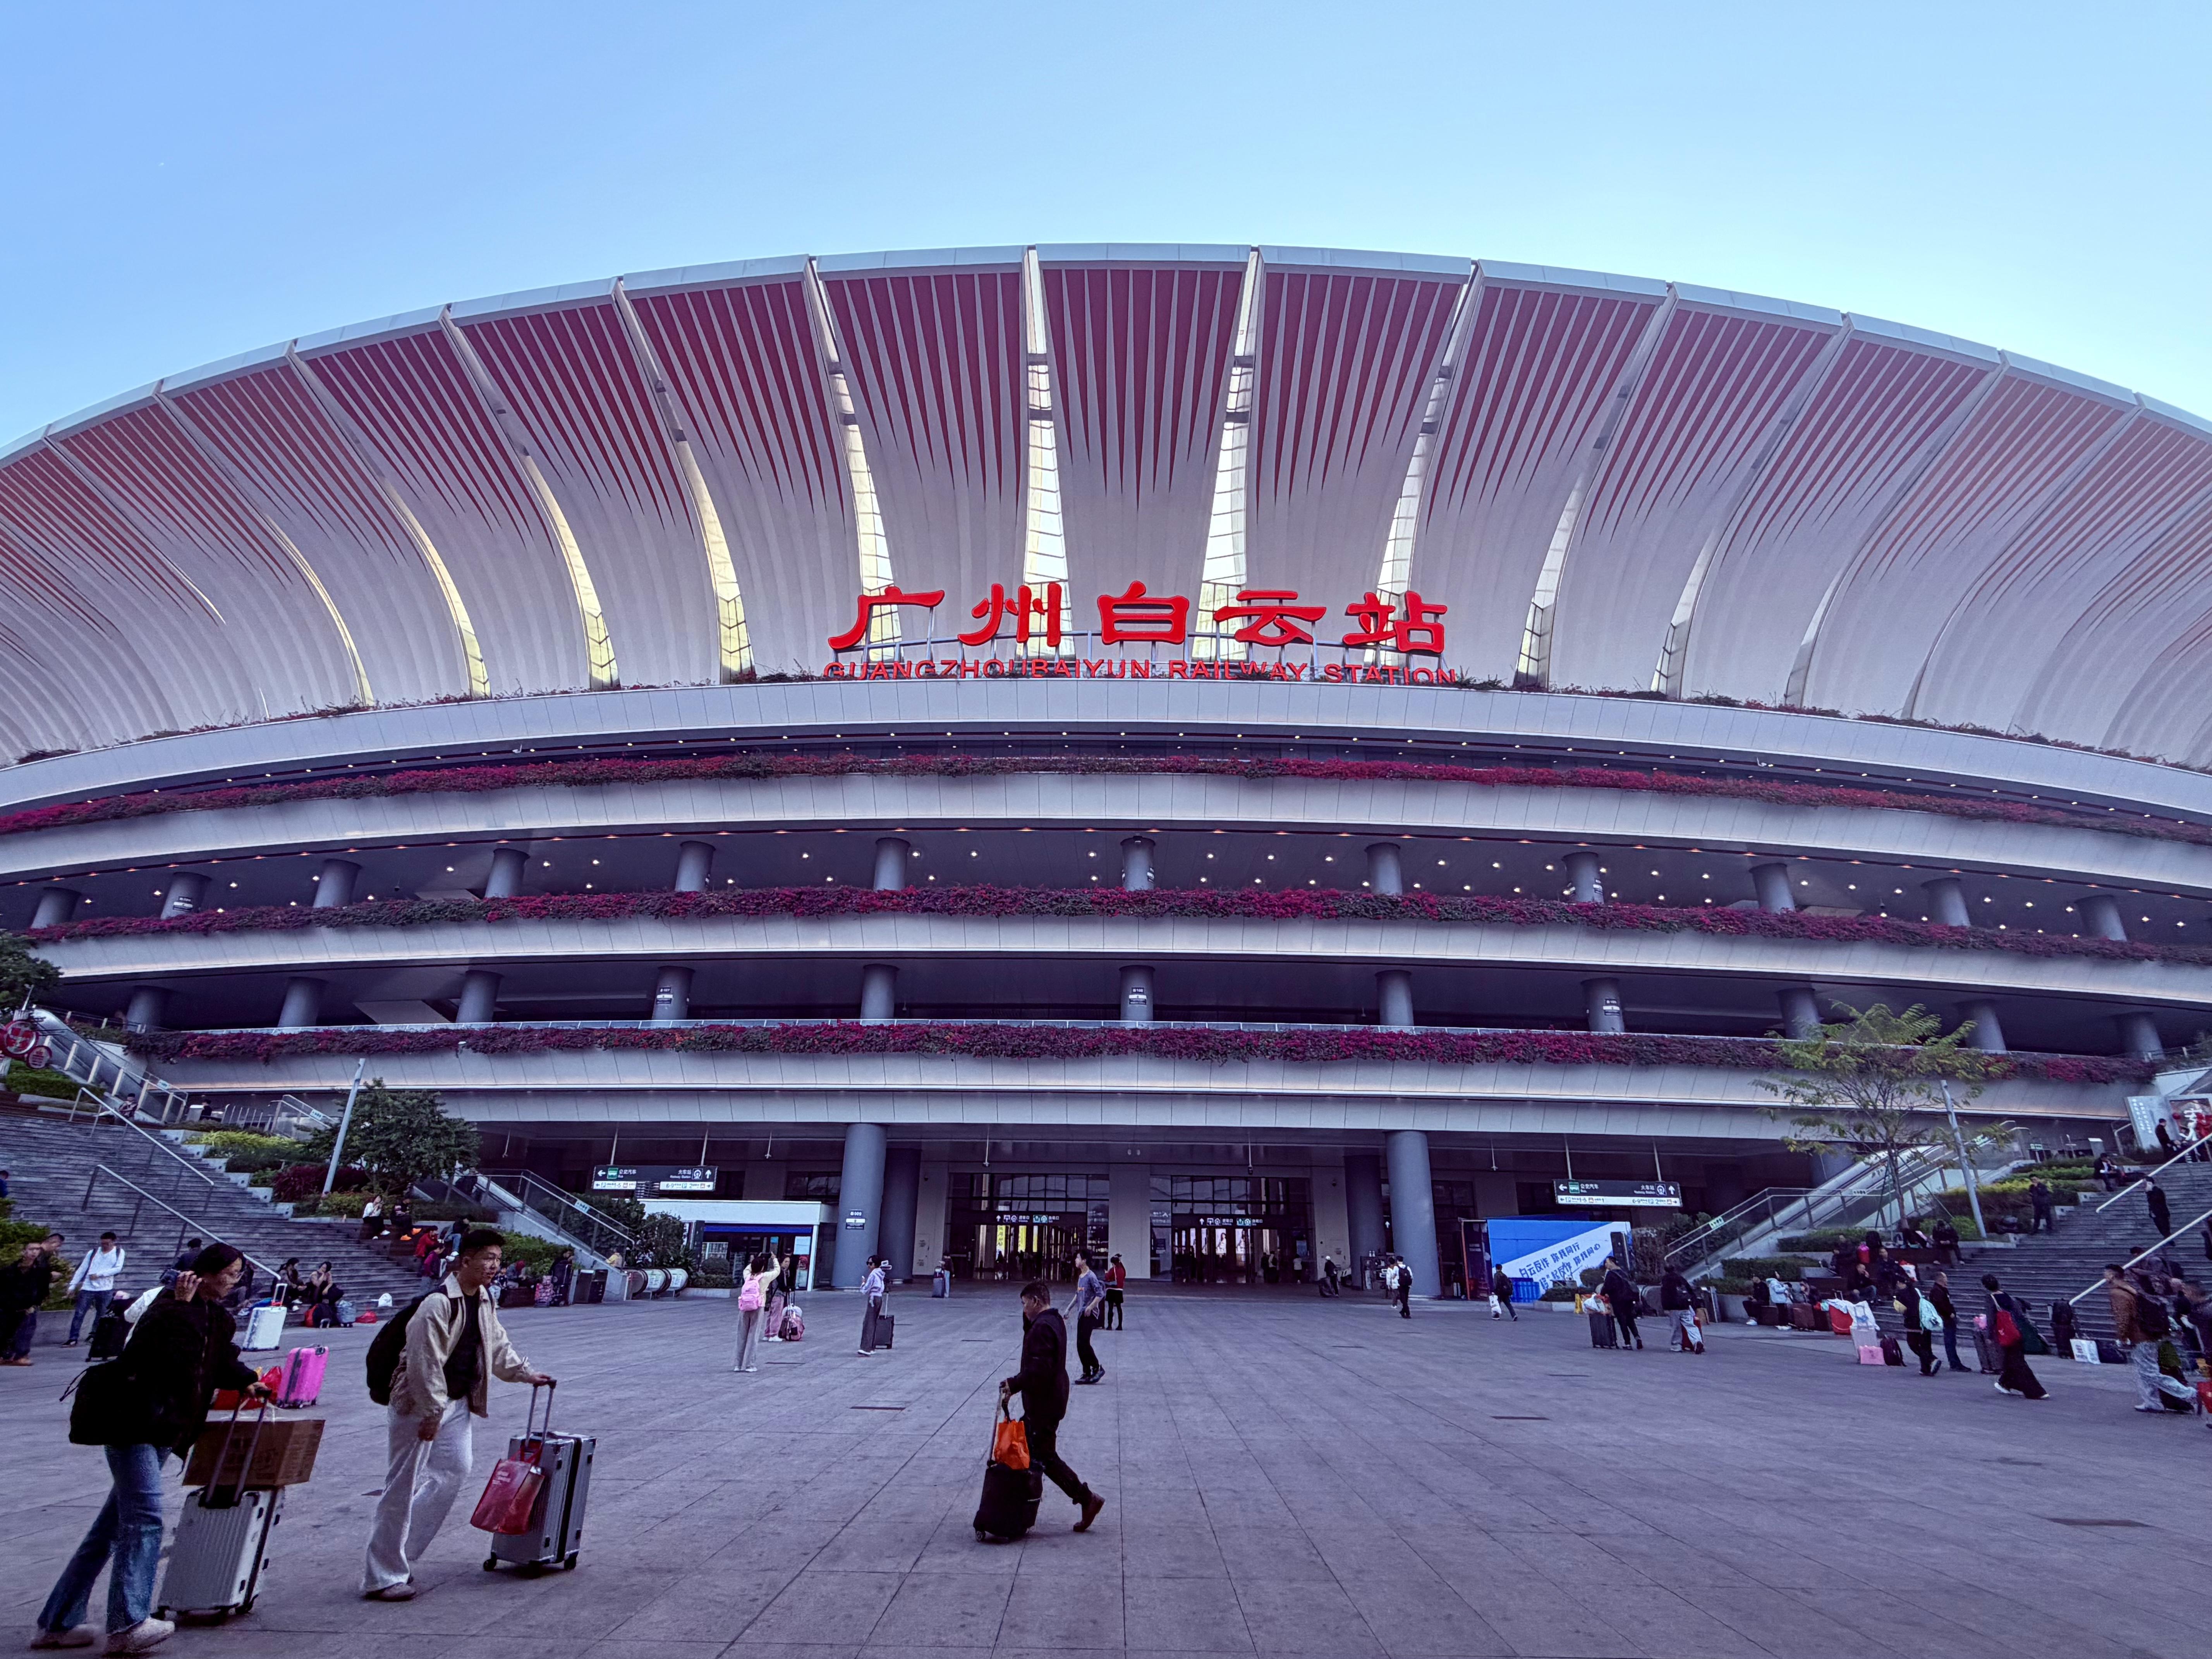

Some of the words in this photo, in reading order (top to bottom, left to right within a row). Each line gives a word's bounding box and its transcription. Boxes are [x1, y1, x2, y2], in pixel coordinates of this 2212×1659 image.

[828, 580, 1448, 653] 广州白云站
[1169, 659, 1308, 682] RAILWAY
[1324, 663, 1457, 685] STATION
